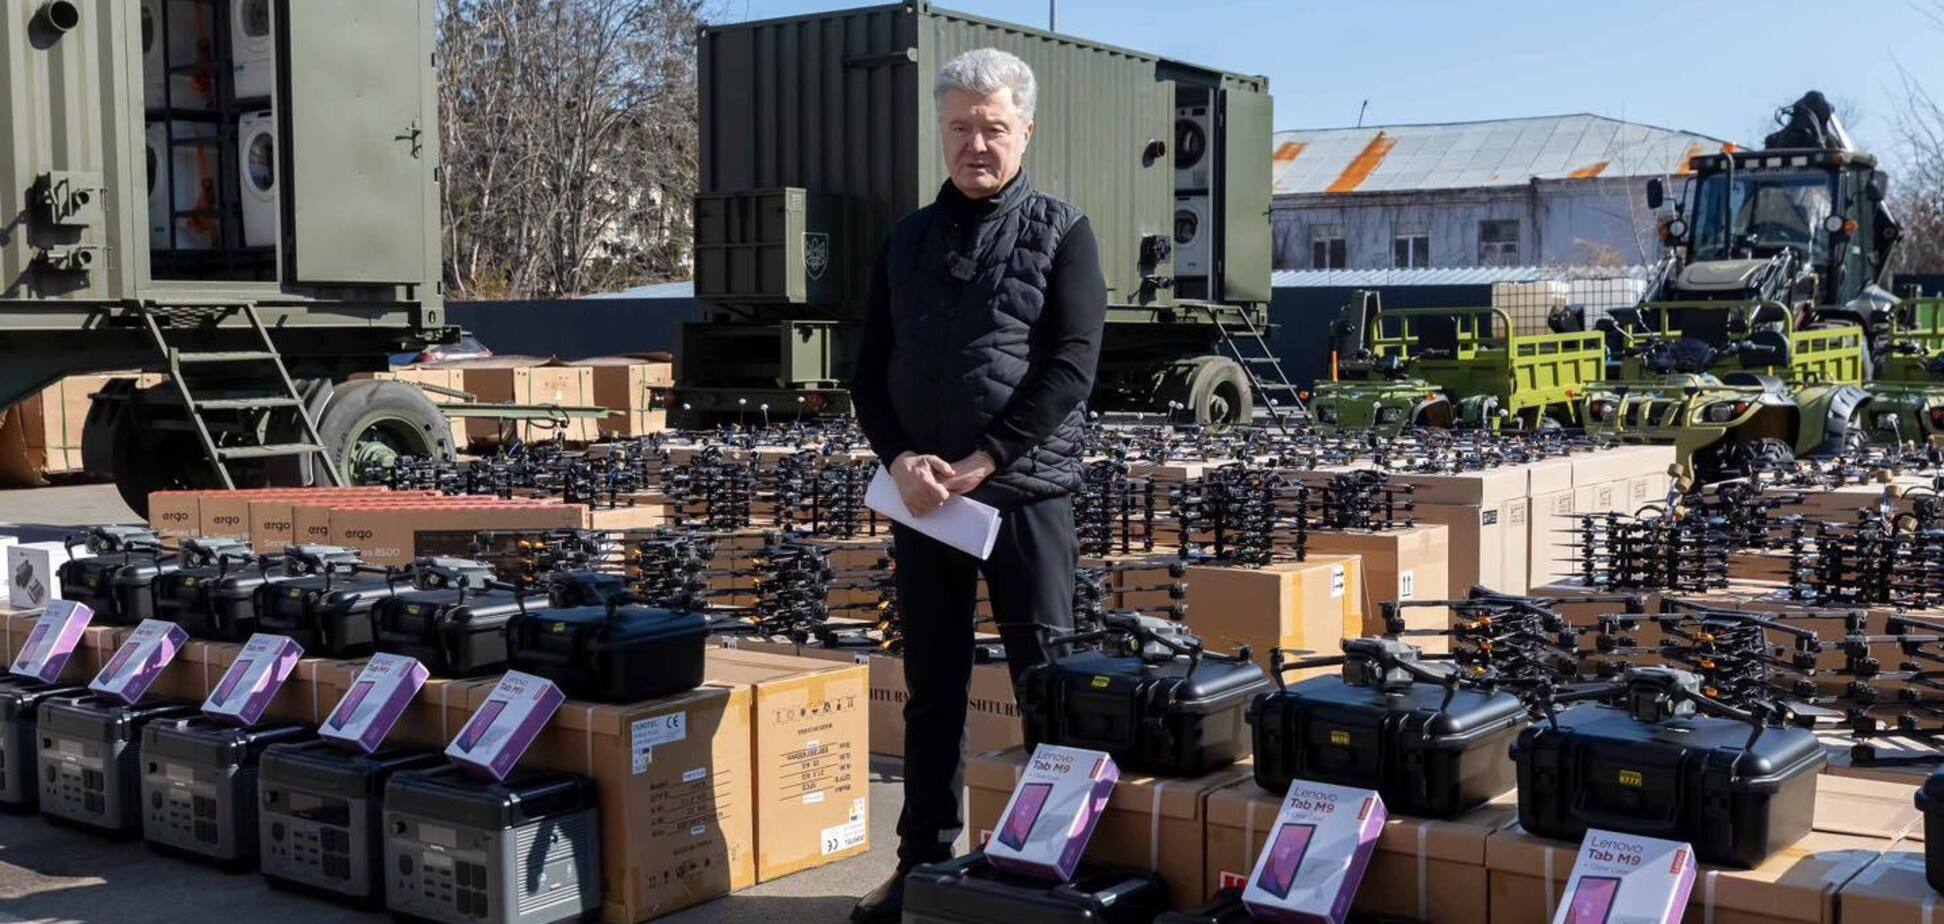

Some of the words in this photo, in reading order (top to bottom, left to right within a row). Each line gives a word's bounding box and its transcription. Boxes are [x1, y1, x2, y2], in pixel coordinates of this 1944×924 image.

[162, 512, 188, 522] ergo
[214, 516, 240, 526] ergo
[264, 522, 291, 532] ergo
[308, 526, 328, 537] erg
[344, 530, 373, 540] ergo
[1033, 760, 1051, 770] Tab
[1052, 763, 1071, 773] M9
[1294, 787, 1337, 802] Lenovo
[1291, 798, 1311, 809] Tab
[1314, 801, 1335, 813] M9
[1591, 836, 1643, 853] Lenovo
[1588, 848, 1613, 861] Tab
[1617, 853, 1641, 865] M9
